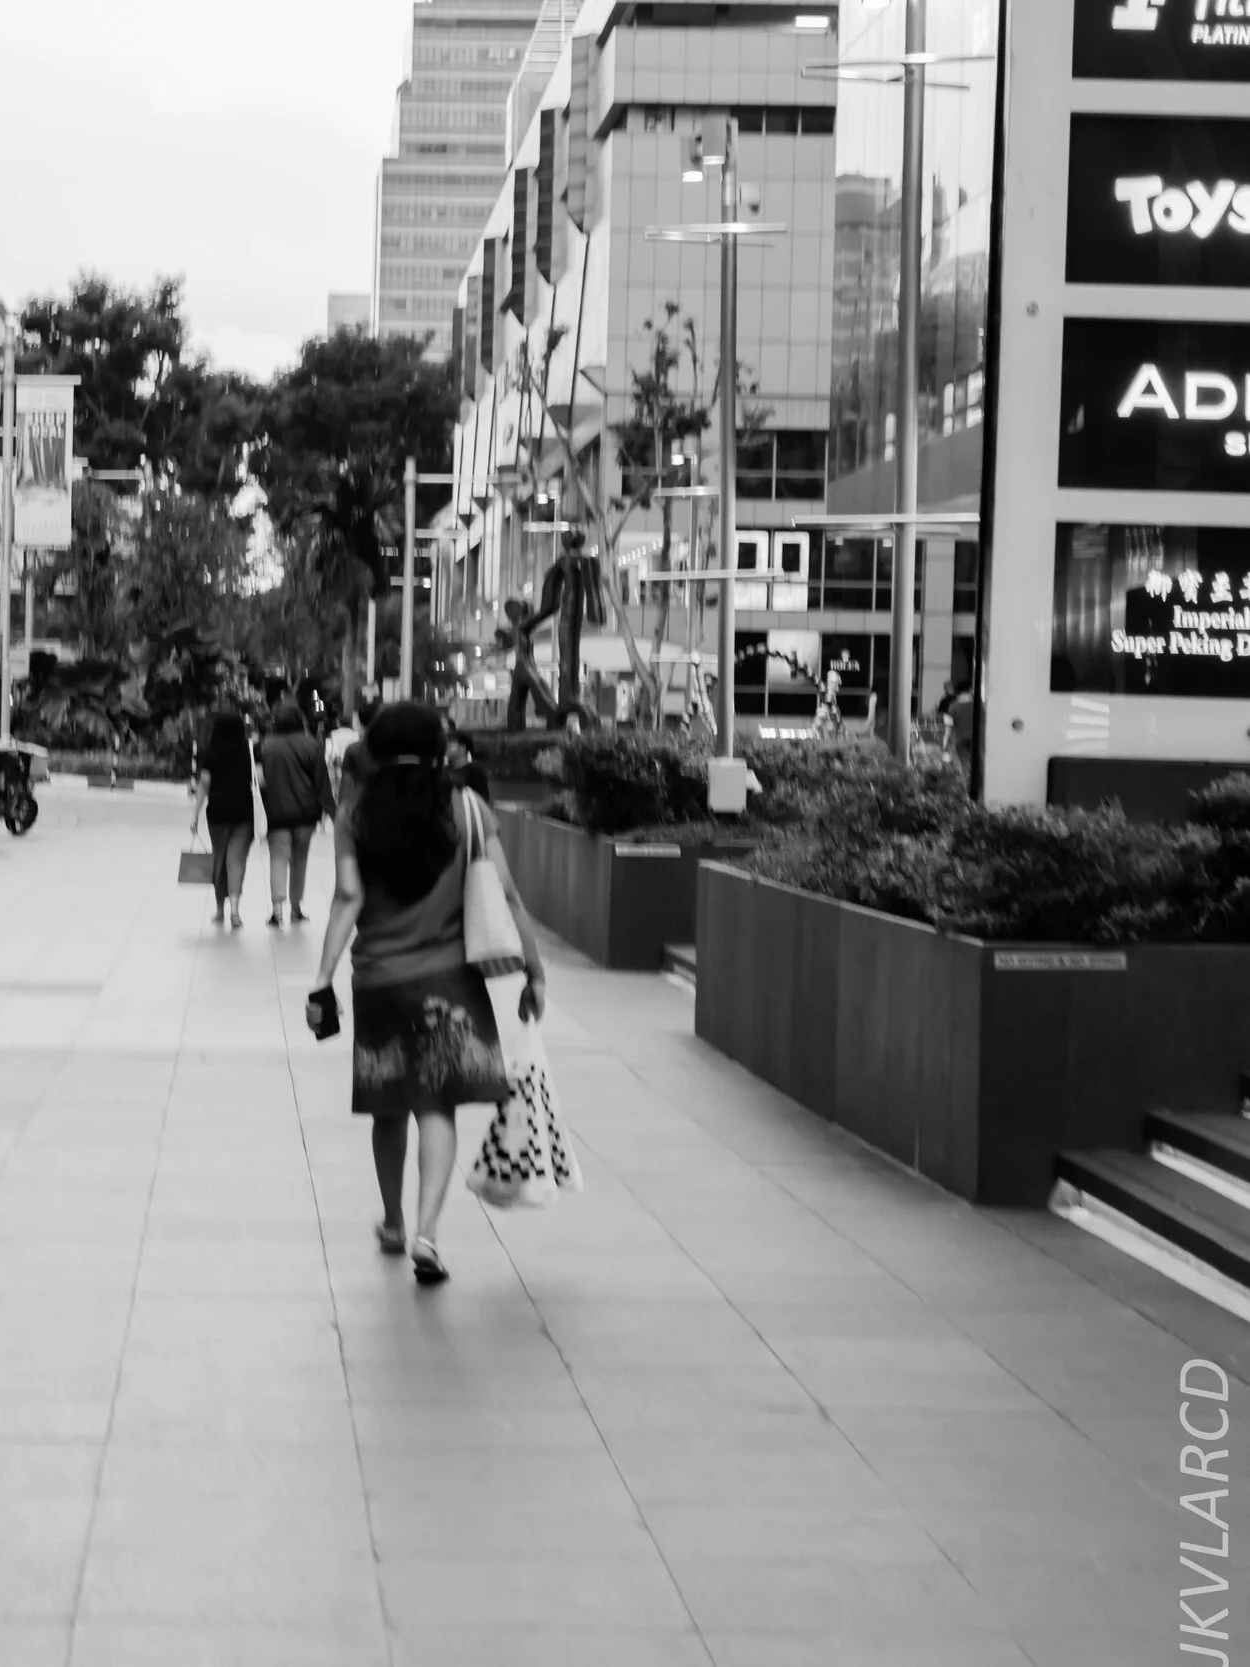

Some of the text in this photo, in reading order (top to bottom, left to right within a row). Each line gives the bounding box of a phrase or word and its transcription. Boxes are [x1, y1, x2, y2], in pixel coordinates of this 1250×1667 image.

[1191, 23, 1250, 45] PLATIN
[1172, 604, 1250, 635] Imperial
[1111, 629, 1166, 659] Super
[1169, 631, 1233, 662] Peking
